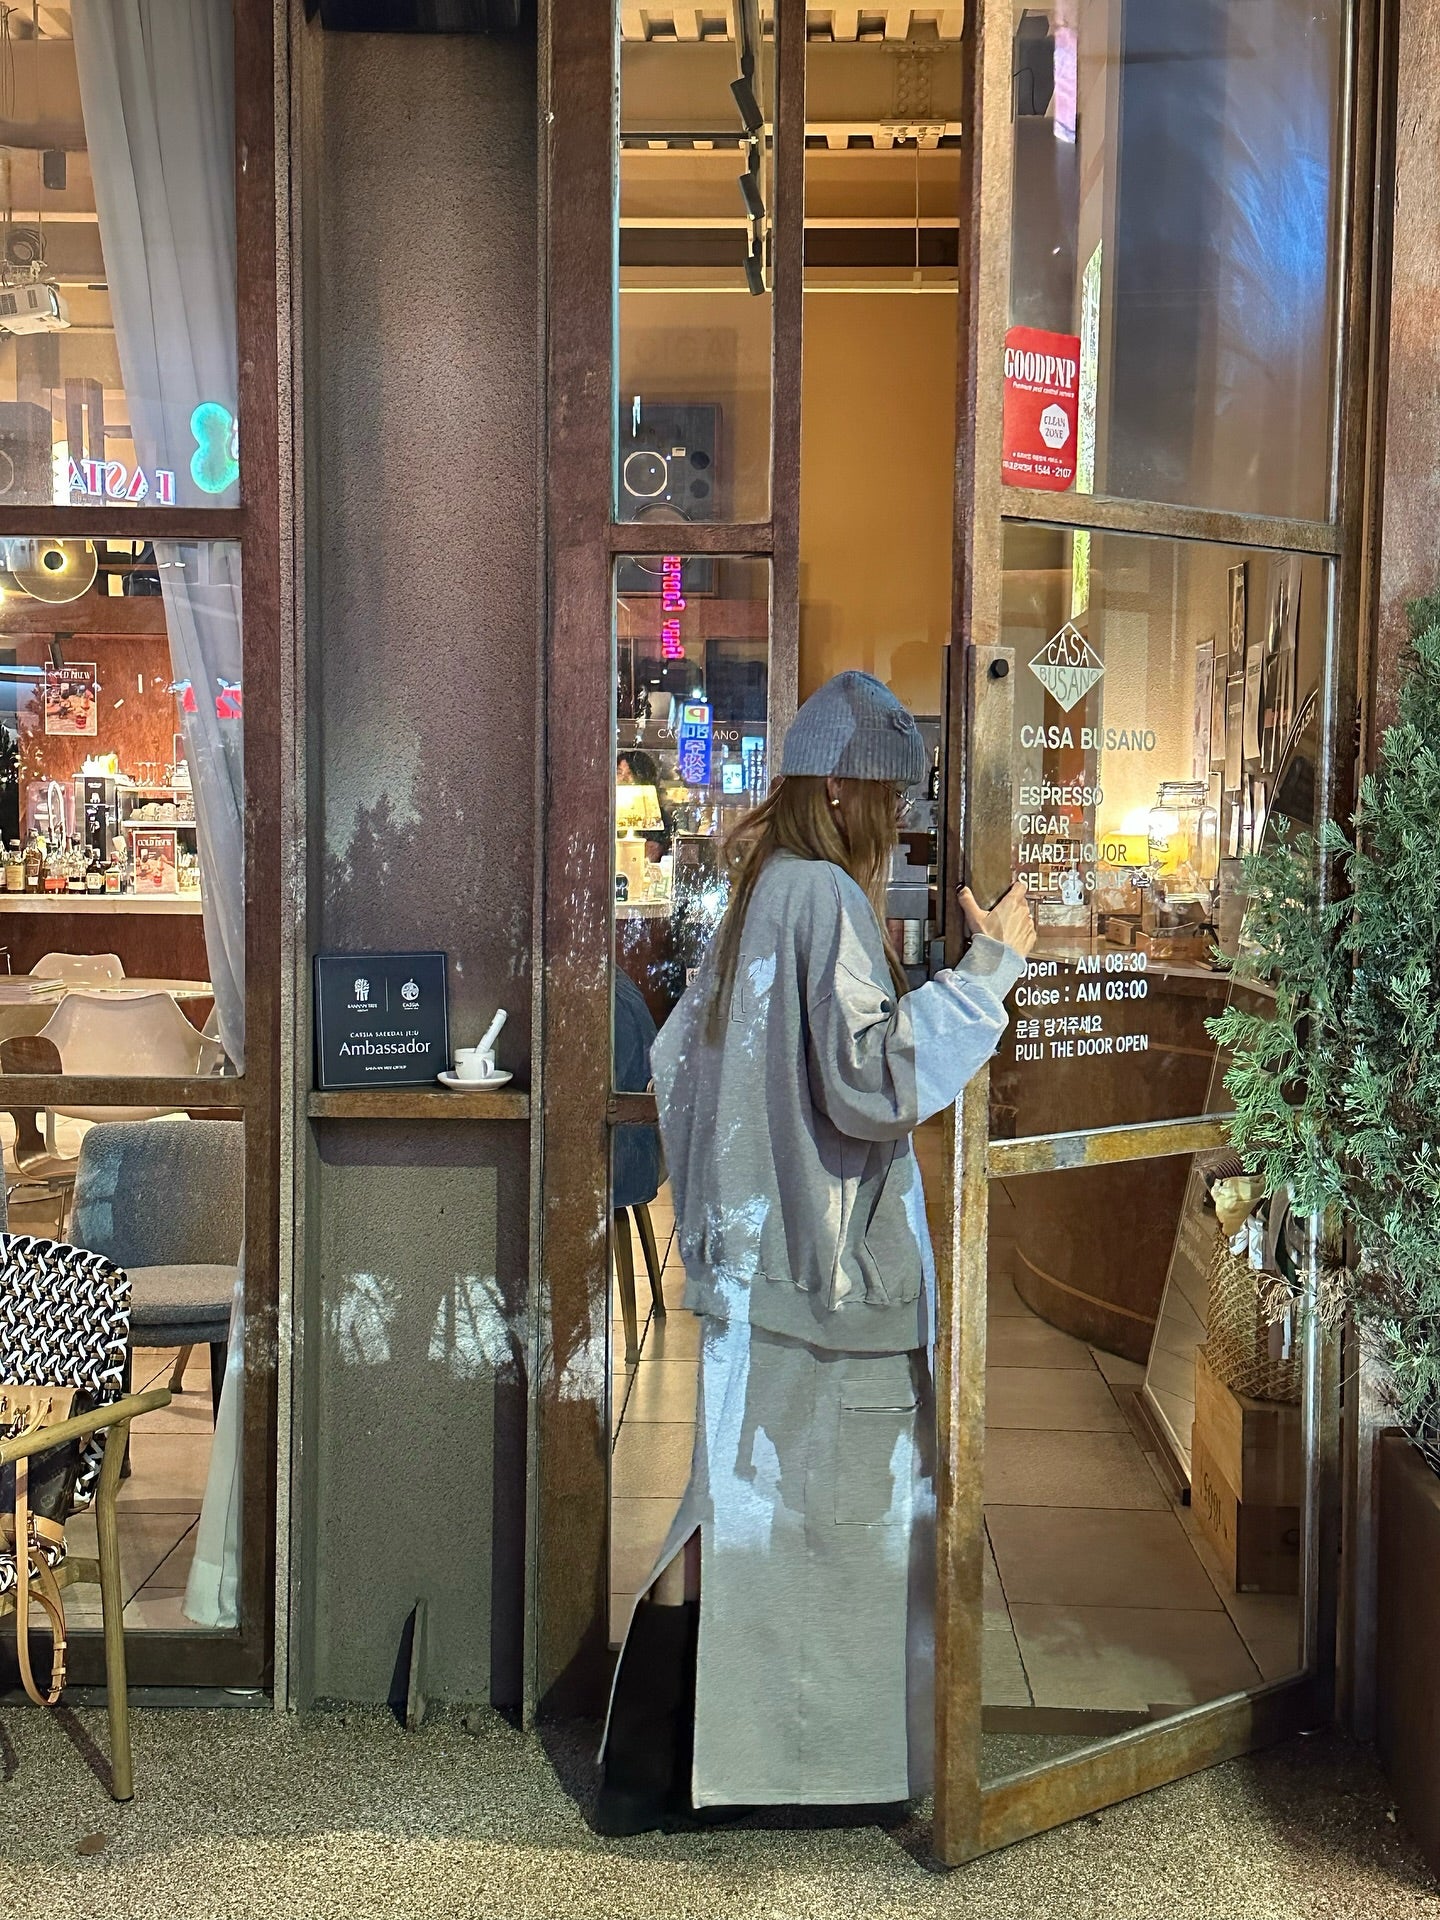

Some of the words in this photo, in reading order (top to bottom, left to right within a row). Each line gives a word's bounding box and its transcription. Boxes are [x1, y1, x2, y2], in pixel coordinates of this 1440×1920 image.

[1004, 347, 1076, 389] GOODPNP
[1044, 415, 1066, 428] CLEAN
[1045, 427, 1064, 439] ZONE
[1047, 632, 1090, 667] CASA
[1039, 667, 1099, 701] BUSANO
[1020, 725, 1074, 750] CASA
[1080, 727, 1156, 751] BUSANO
[1019, 786, 1104, 807] ESPRESSO
[1018, 815, 1070, 835] CIGAR
[1018, 843, 1064, 863] HARD
[1069, 843, 1128, 863] LIQUOR
[1075, 955, 1101, 975] AM
[1105, 952, 1147, 973] 08:30
[1015, 987, 1060, 1007] Close
[1075, 983, 1101, 1003] AM
[1105, 979, 1148, 1000] 03:00
[1015, 1019, 1040, 1039] 문을
[1044, 1015, 1103, 1038] 당겨주세요
[339, 1038, 431, 1056] Ambassador
[1050, 1040, 1074, 1059] THE
[1077, 1037, 1113, 1057] DOOR
[1116, 1034, 1149, 1054] OPEN
